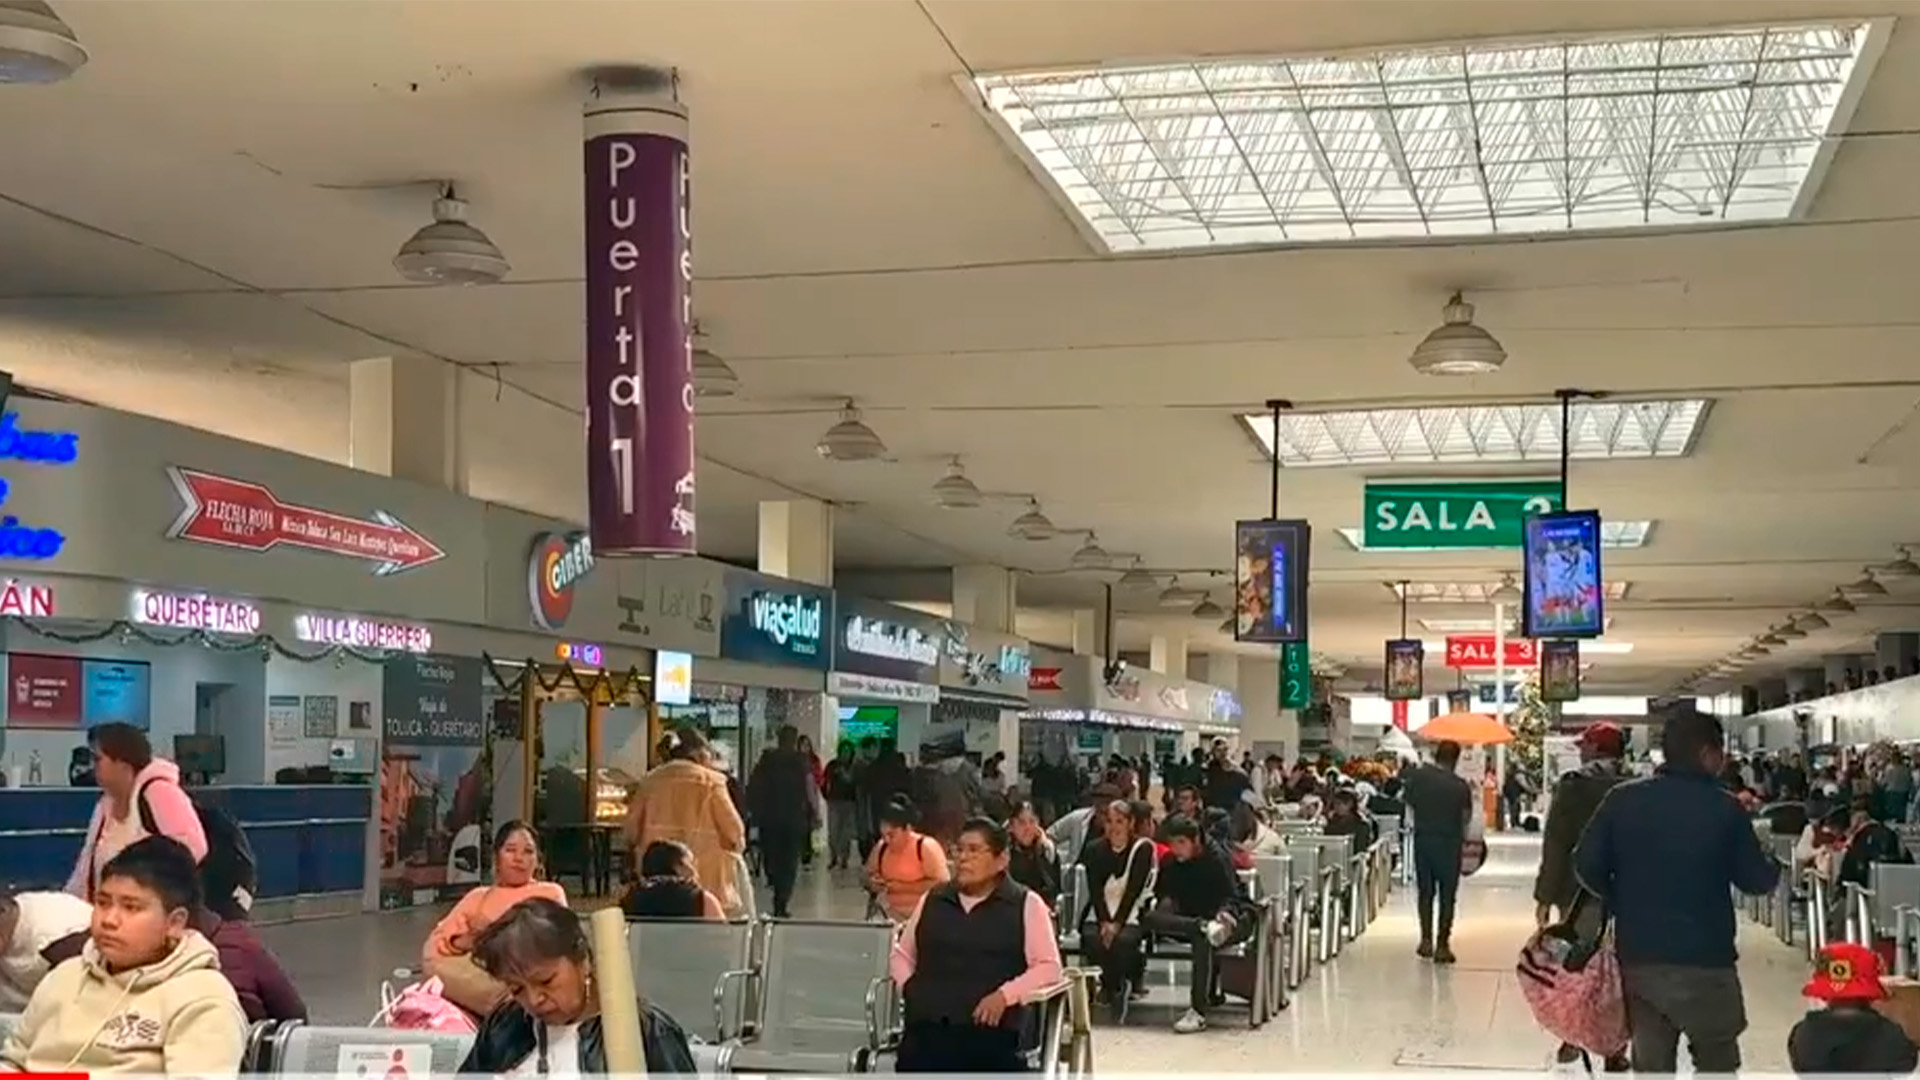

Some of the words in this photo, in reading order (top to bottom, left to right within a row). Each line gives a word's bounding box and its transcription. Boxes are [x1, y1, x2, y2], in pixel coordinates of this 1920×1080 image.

[609, 142, 640, 405] Puerta
[610, 438, 633, 515] 1
[205, 499, 247, 525] FLECHA
[248, 507, 274, 531] ROJA
[1376, 501, 1496, 531] SALA
[145, 591, 260, 633] QUERÉTARO
[308, 614, 351, 643] VILLA
[355, 620, 431, 650] GUERRERO
[1520, 643, 1533, 659] 3
[1287, 679, 1300, 701] 2
[387, 718, 423, 736] TOLUCA
